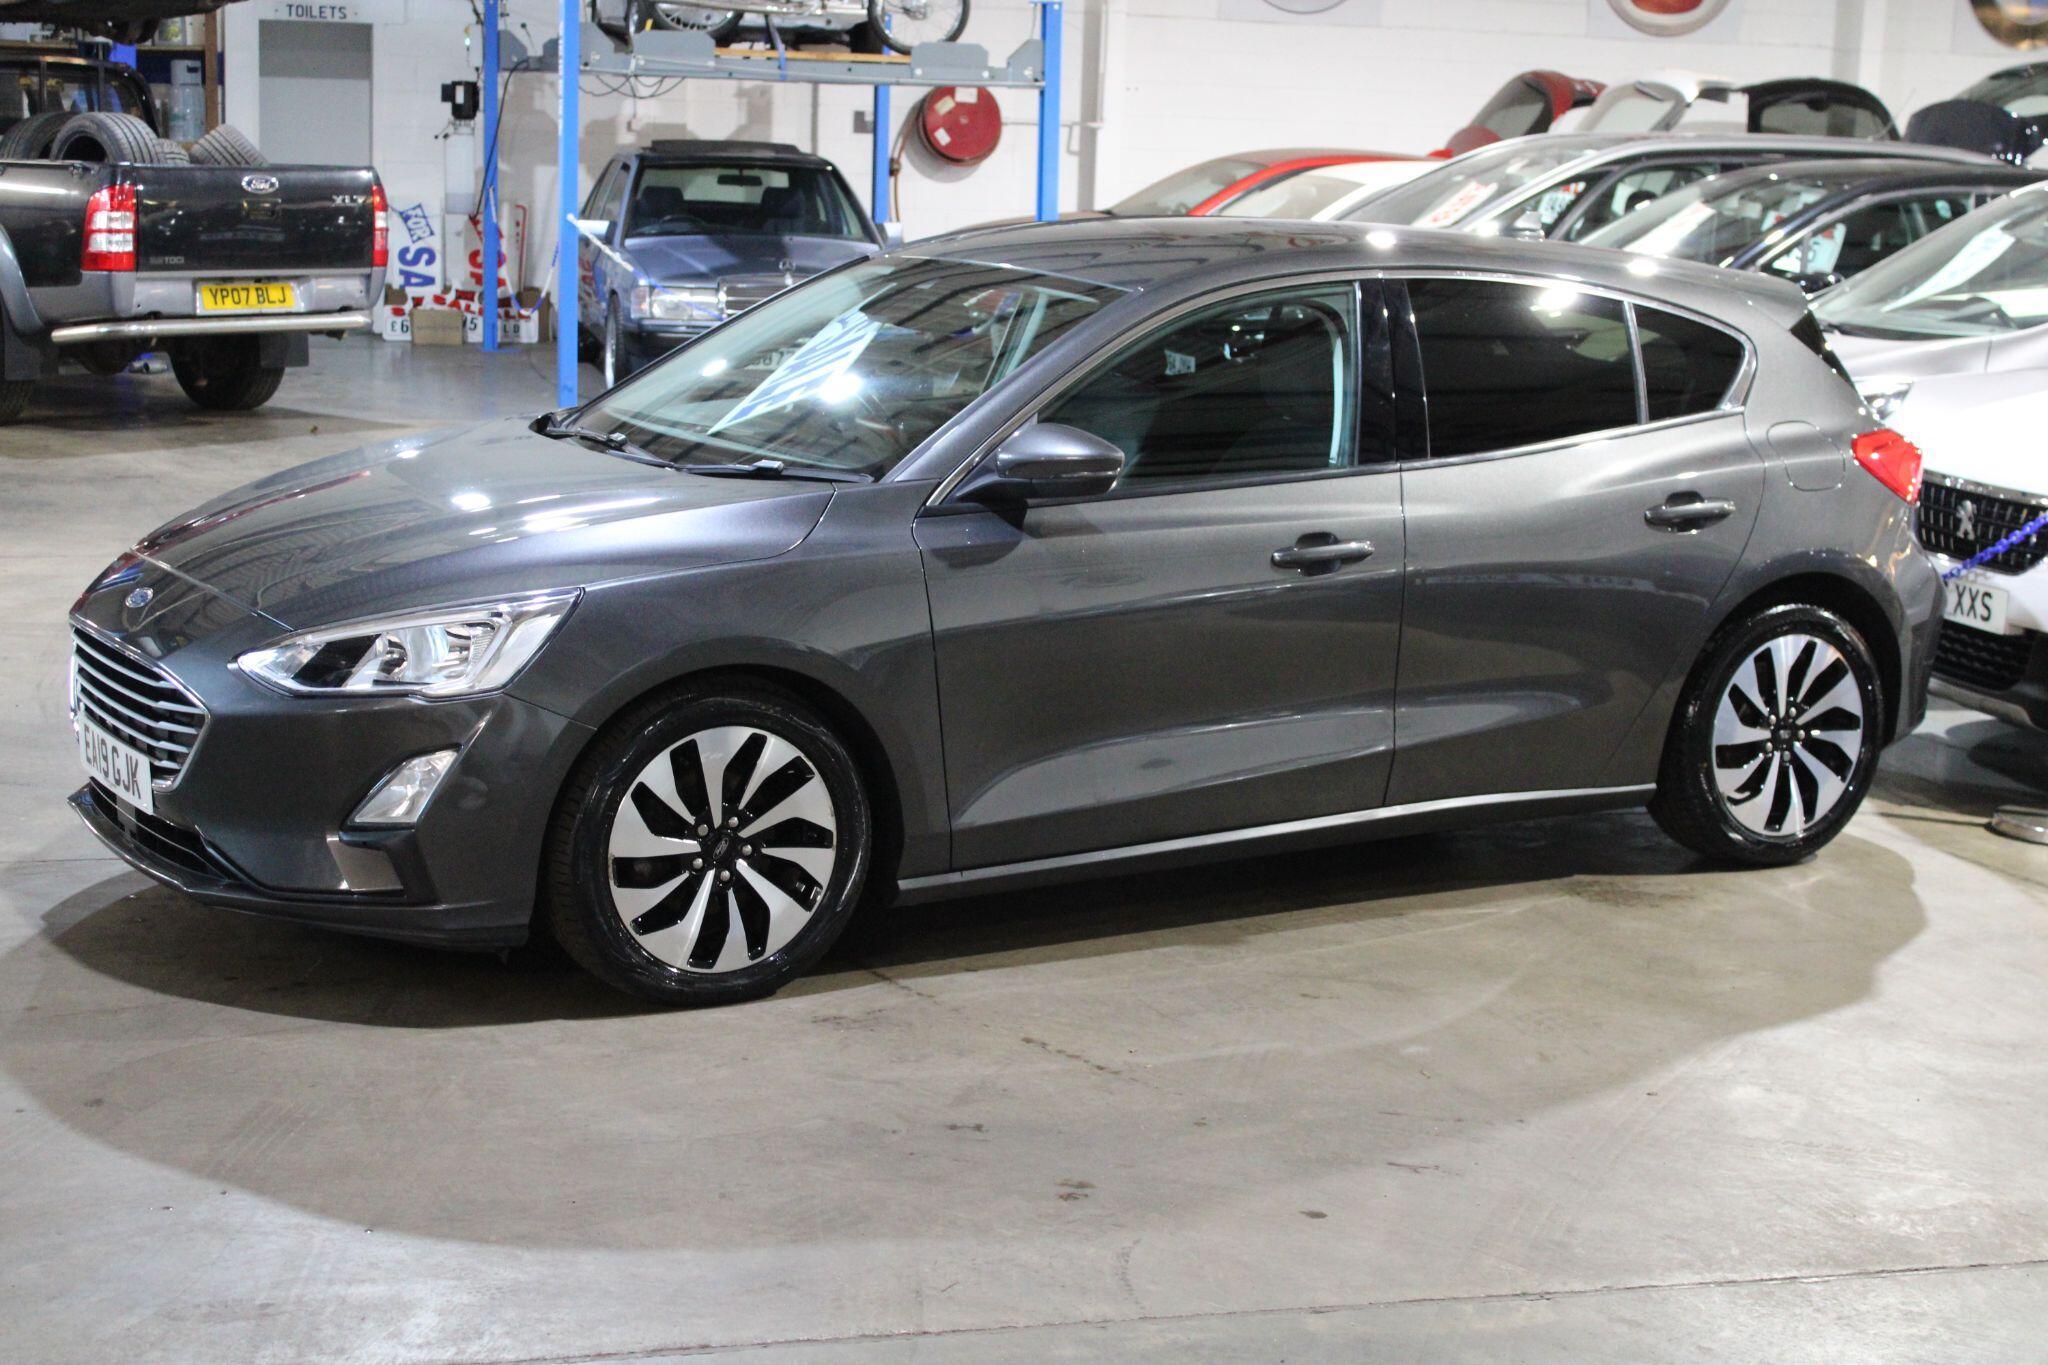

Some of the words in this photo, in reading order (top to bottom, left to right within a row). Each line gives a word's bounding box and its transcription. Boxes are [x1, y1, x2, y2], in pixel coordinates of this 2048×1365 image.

[286, 4, 347, 20] TOILETS
[331, 194, 368, 208] XLT
[402, 207, 431, 241] FOR
[208, 286, 250, 306] YP07
[254, 285, 287, 305] BLJ
[1953, 583, 1993, 623] XXS
[83, 722, 109, 779] EA19
[111, 744, 142, 800] GJK
